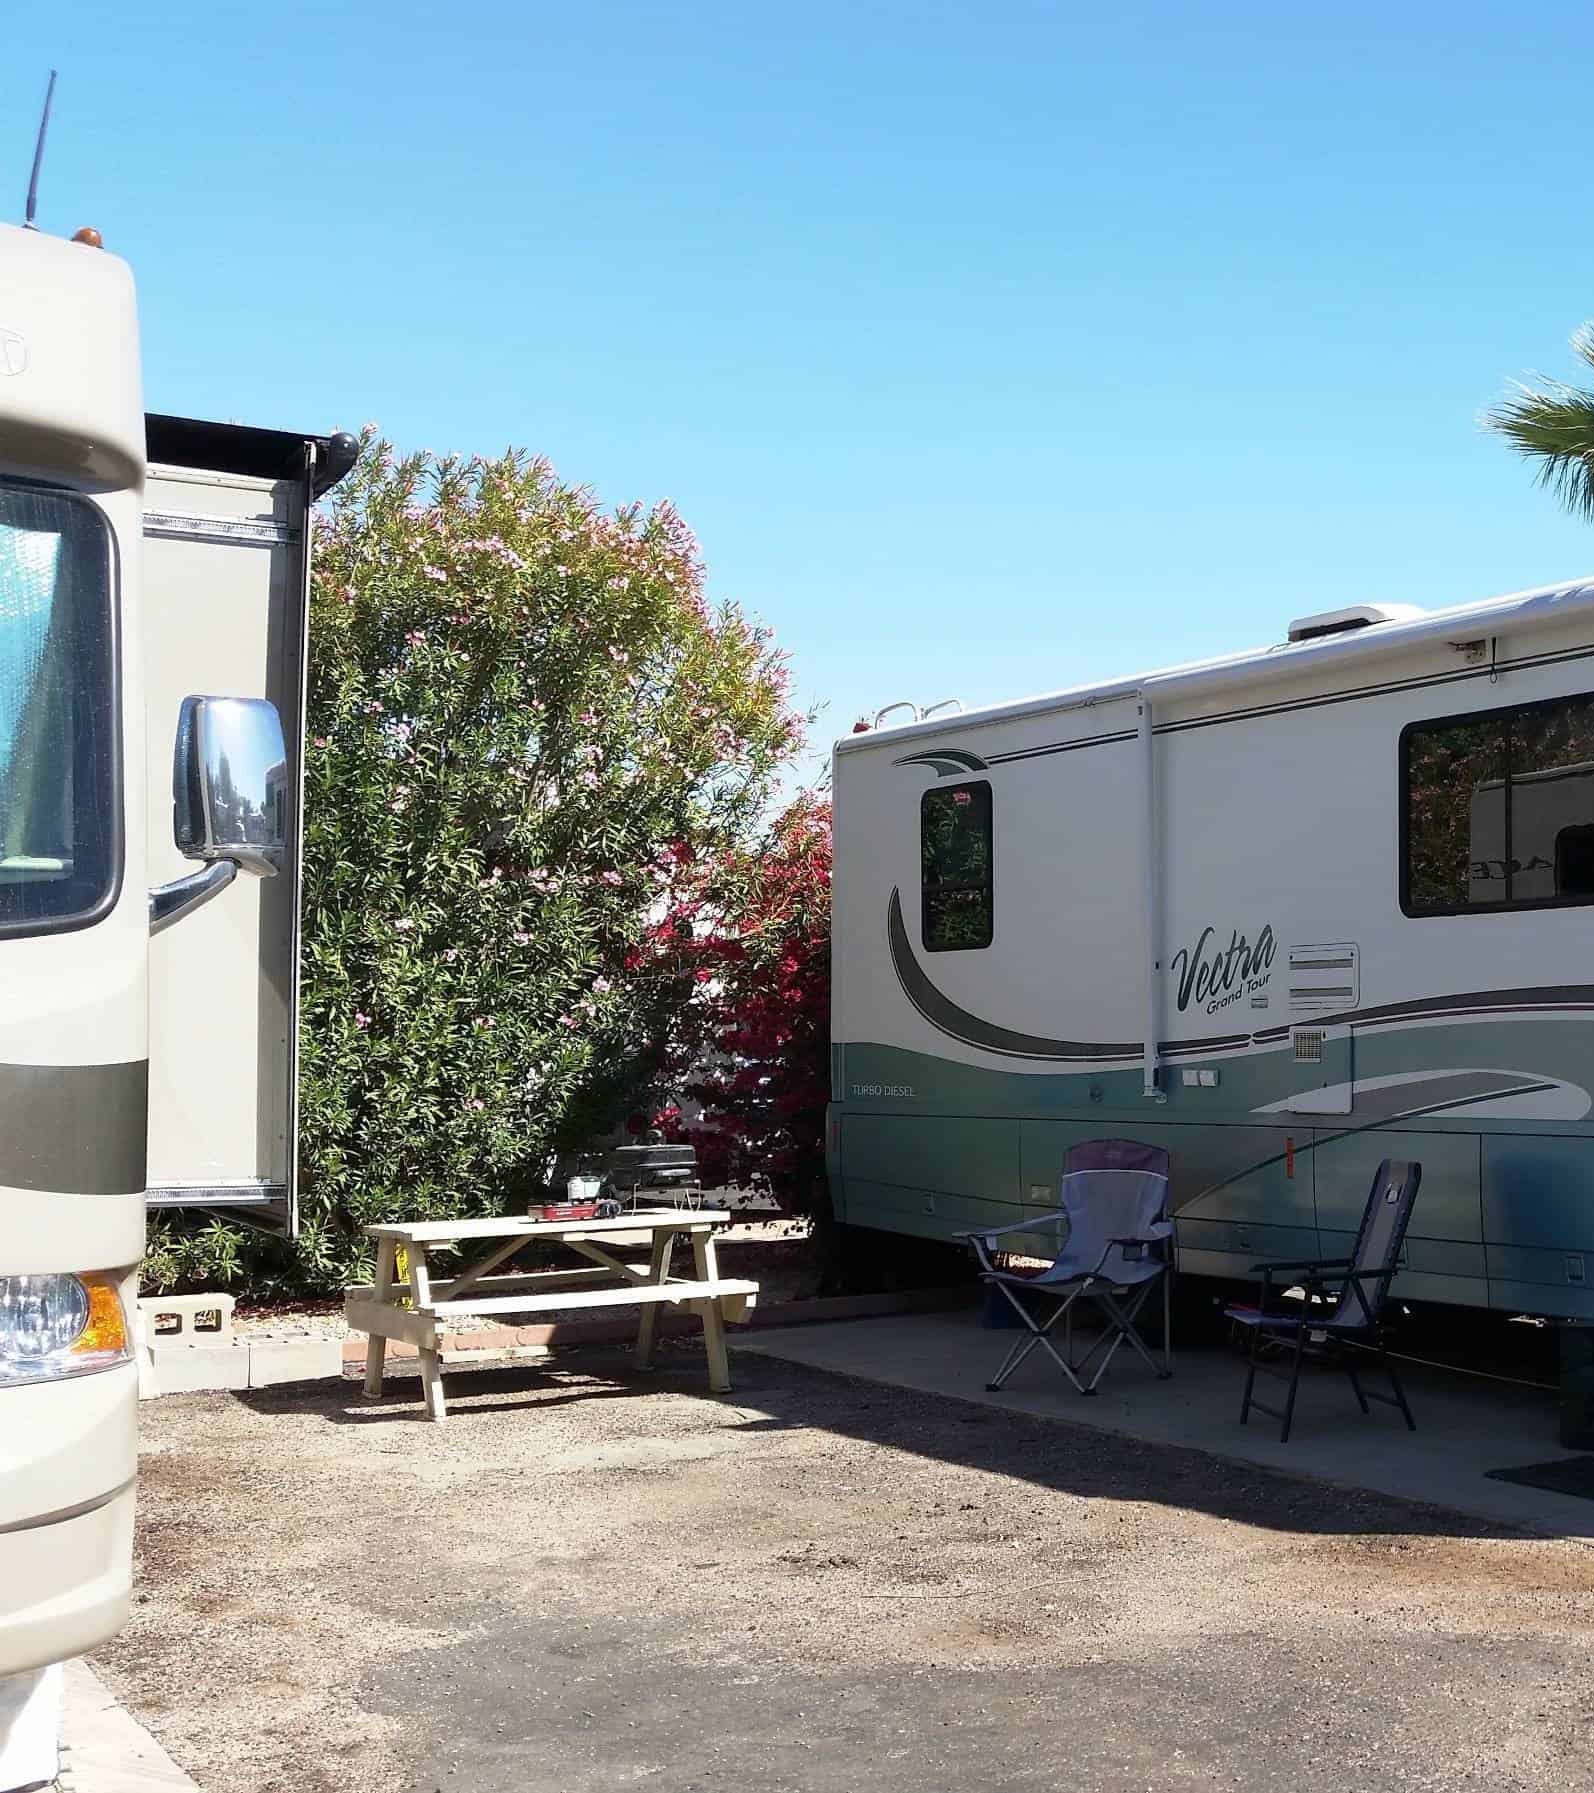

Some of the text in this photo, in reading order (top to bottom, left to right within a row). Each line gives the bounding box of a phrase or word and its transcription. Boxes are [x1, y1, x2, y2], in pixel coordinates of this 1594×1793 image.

[1172, 924, 1278, 1012] Vectra
[1206, 973, 1272, 1015] Grand Tour
[851, 1084, 917, 1098] TURBO DIESEL
